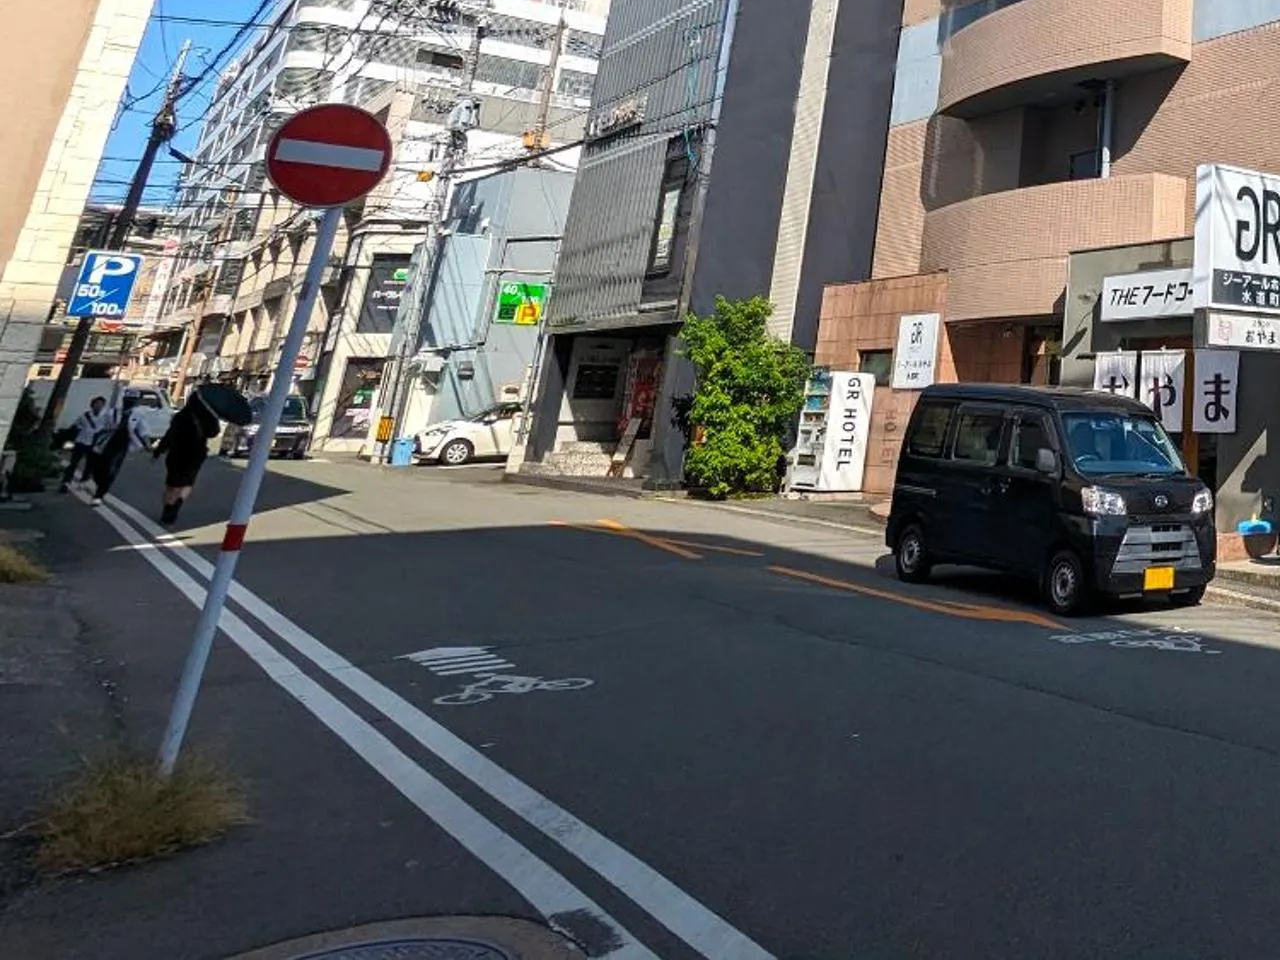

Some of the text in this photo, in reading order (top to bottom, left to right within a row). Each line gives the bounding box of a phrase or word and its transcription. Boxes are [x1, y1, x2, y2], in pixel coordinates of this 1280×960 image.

[88, 254, 134, 284] P
[1242, 289, 1279, 307] 水道町
[836, 378, 861, 471] GR HOTEL
